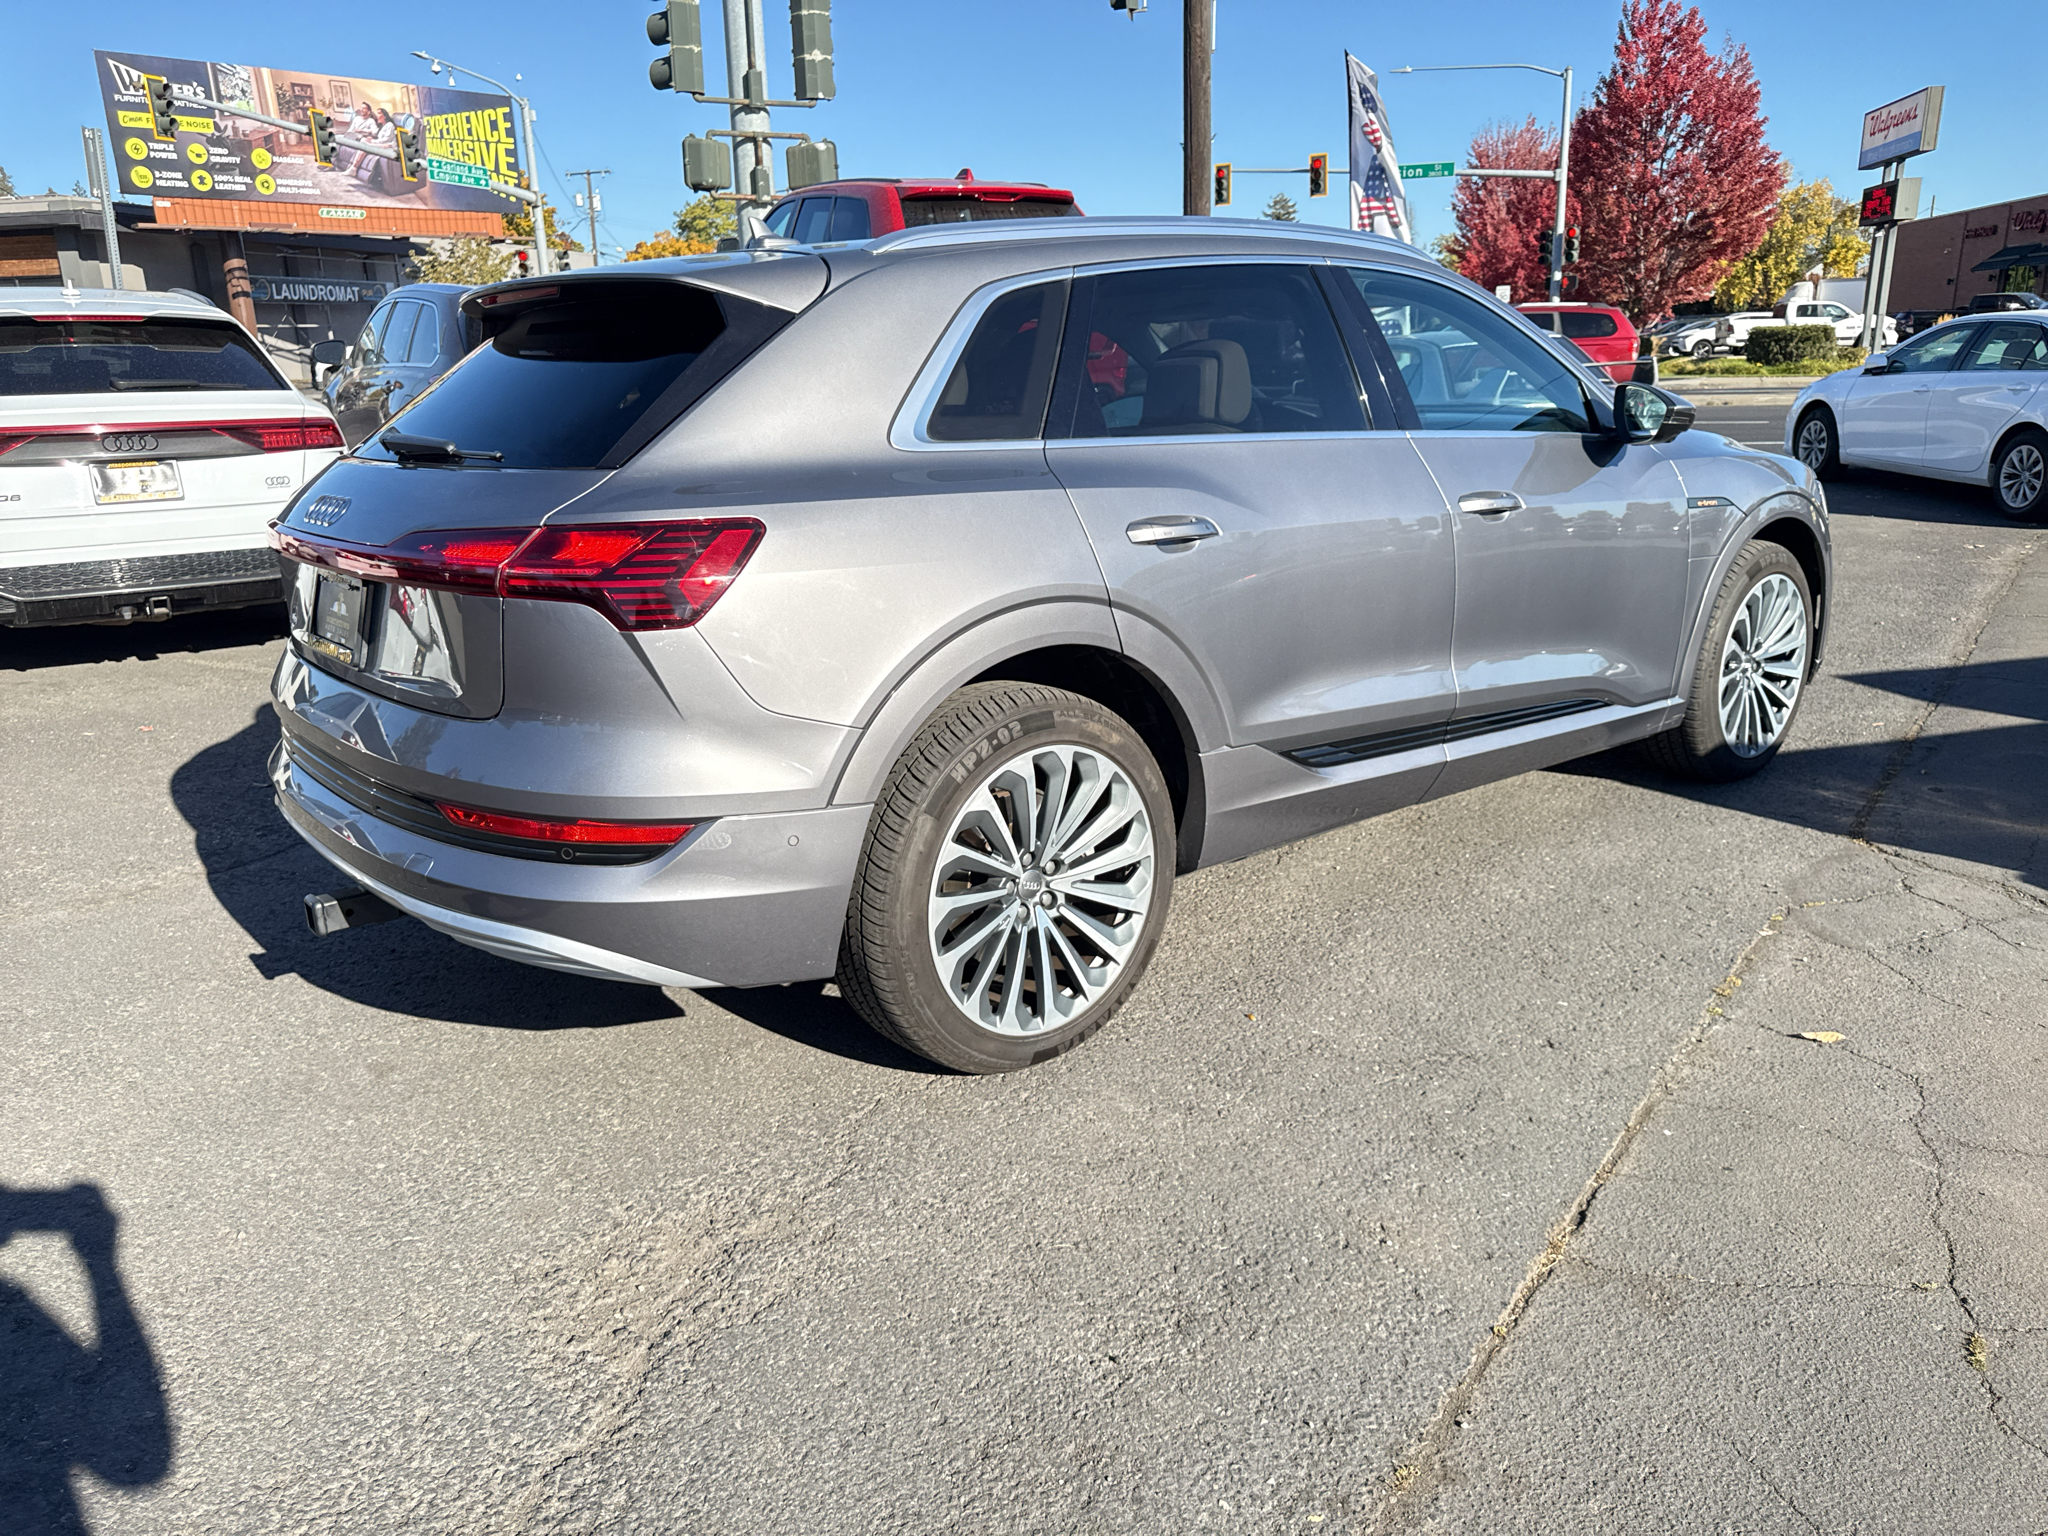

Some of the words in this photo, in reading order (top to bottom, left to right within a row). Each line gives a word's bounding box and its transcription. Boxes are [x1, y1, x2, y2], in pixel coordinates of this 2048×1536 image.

[114, 93, 150, 104] FURNITU
[186, 120, 212, 129] NOISE
[423, 106, 515, 144] EXPERIENCE
[1869, 102, 1919, 140] Walgreens
[148, 142, 175, 151] TRIPLE
[209, 147, 229, 155] ZERO
[149, 151, 178, 160] POWER
[210, 155, 241, 164] GRAVITY
[273, 156, 304, 164] MASSAGE
[426, 138, 518, 178] IMMERSIVE
[441, 162, 468, 174] Garland
[1434, 163, 1442, 171] St
[213, 174, 234, 183] 100%
[234, 175, 253, 184] REAL
[433, 171, 459, 182] Empire
[155, 179, 189, 188] HEATING
[214, 182, 247, 191] LEATHER
[276, 178, 313, 187] IMMERSIVE
[277, 186, 321, 195] MULTI-MEDIA
[323, 209, 360, 218] LAMAR
[271, 282, 360, 302] LAUNDROMAT
[1696, 499, 1718, 507] e-tron
[1059, 709, 1075, 718] ALL
[1082, 712, 1123, 736] SEASON
[950, 720, 1024, 785] HPZ-02
